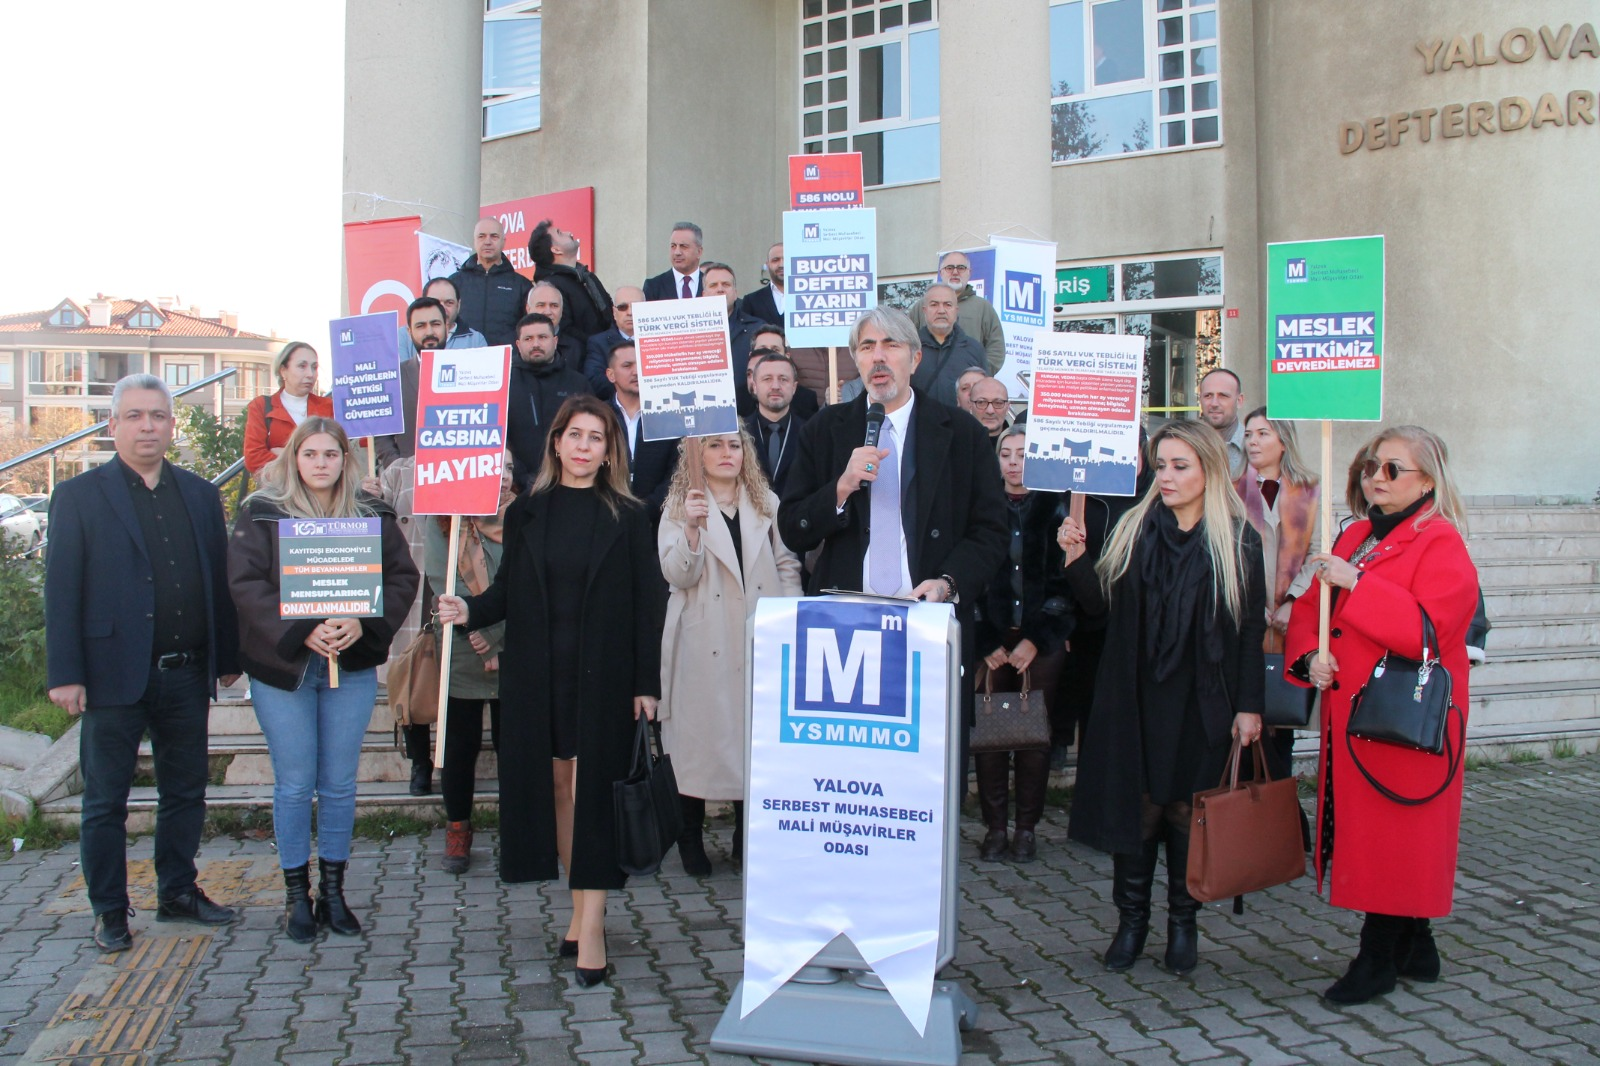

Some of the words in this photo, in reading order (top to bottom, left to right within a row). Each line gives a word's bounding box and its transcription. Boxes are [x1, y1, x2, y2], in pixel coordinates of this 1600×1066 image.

[1415, 22, 1600, 74] YALOVA
[1340, 89, 1600, 155] DEFTERDAR
[800, 194, 820, 203] 586
[822, 192, 854, 202] NOLU
[493, 210, 525, 234] OVA
[796, 254, 864, 274] BUGÜN
[794, 276, 868, 292] DEFTER
[1055, 276, 1091, 296] İRİŞ
[801, 294, 860, 309] YARIN
[1008, 280, 1034, 310] M
[638, 324, 661, 332] TÜRK
[664, 321, 688, 330] VERGİ
[690, 317, 724, 328] SİSTEMİ
[794, 312, 862, 327] MESLE
[1004, 314, 1043, 325] YSMMMO
[1278, 316, 1374, 336] MESLEK
[1096, 351, 1124, 360] TEBLİĞİ
[1126, 352, 1137, 360] İLE
[1277, 340, 1373, 358] YETKİMİZ
[355, 361, 376, 372] MALİ
[1038, 357, 1063, 366] TÜRK
[1066, 358, 1096, 368] VERGİ
[1098, 359, 1137, 370] SİSTEMİ
[1276, 358, 1376, 372] DEVREDİLEMEZ!
[335, 370, 397, 386] MÜŞAVİRLERİN
[352, 383, 382, 395] YETKİSİ
[346, 394, 389, 407] KAMUNUN
[346, 407, 392, 420] GÜVENCESİ
[436, 403, 488, 425] YETKİ
[420, 429, 502, 446] GASBINA
[417, 452, 502, 486] HAYIR!
[325, 546, 372, 554] EKONOMİYLE
[306, 556, 355, 564] MÜCADELEDE
[290, 589, 370, 598] MENSUPLARINCA
[282, 602, 370, 614] ONAYLANMALIDIR
[805, 627, 882, 706] M
[789, 722, 911, 747] YSMMMO
[813, 778, 884, 797] YALOVA
[762, 798, 830, 813] SERBEST
[834, 802, 933, 823] MUHASEBECİ
[778, 818, 814, 832] MALİ
[819, 820, 916, 841] MÜŞAVİRLER
[823, 841, 869, 856] ODASI
